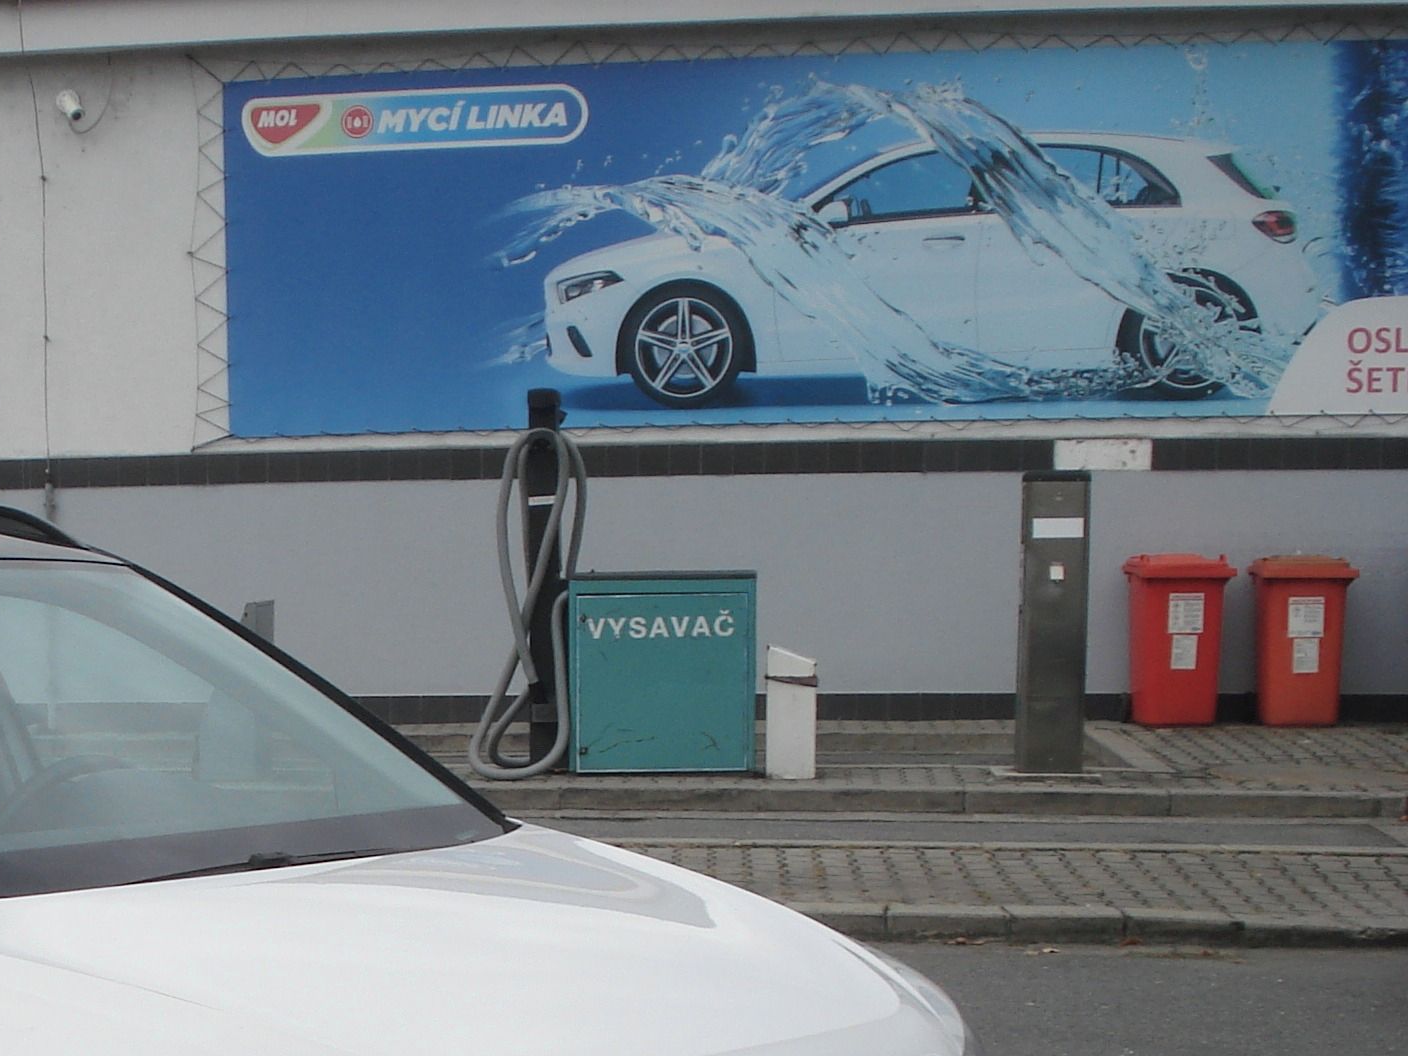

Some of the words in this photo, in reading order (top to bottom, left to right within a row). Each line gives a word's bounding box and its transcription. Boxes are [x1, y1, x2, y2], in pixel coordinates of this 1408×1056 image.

[257, 108, 298, 128] MOL
[376, 99, 466, 135] MYCÍ
[466, 102, 569, 131] LINKA
[1347, 327, 1408, 354] OSL
[1346, 359, 1408, 394] ŠET
[586, 609, 735, 640] VYSAVAČ
